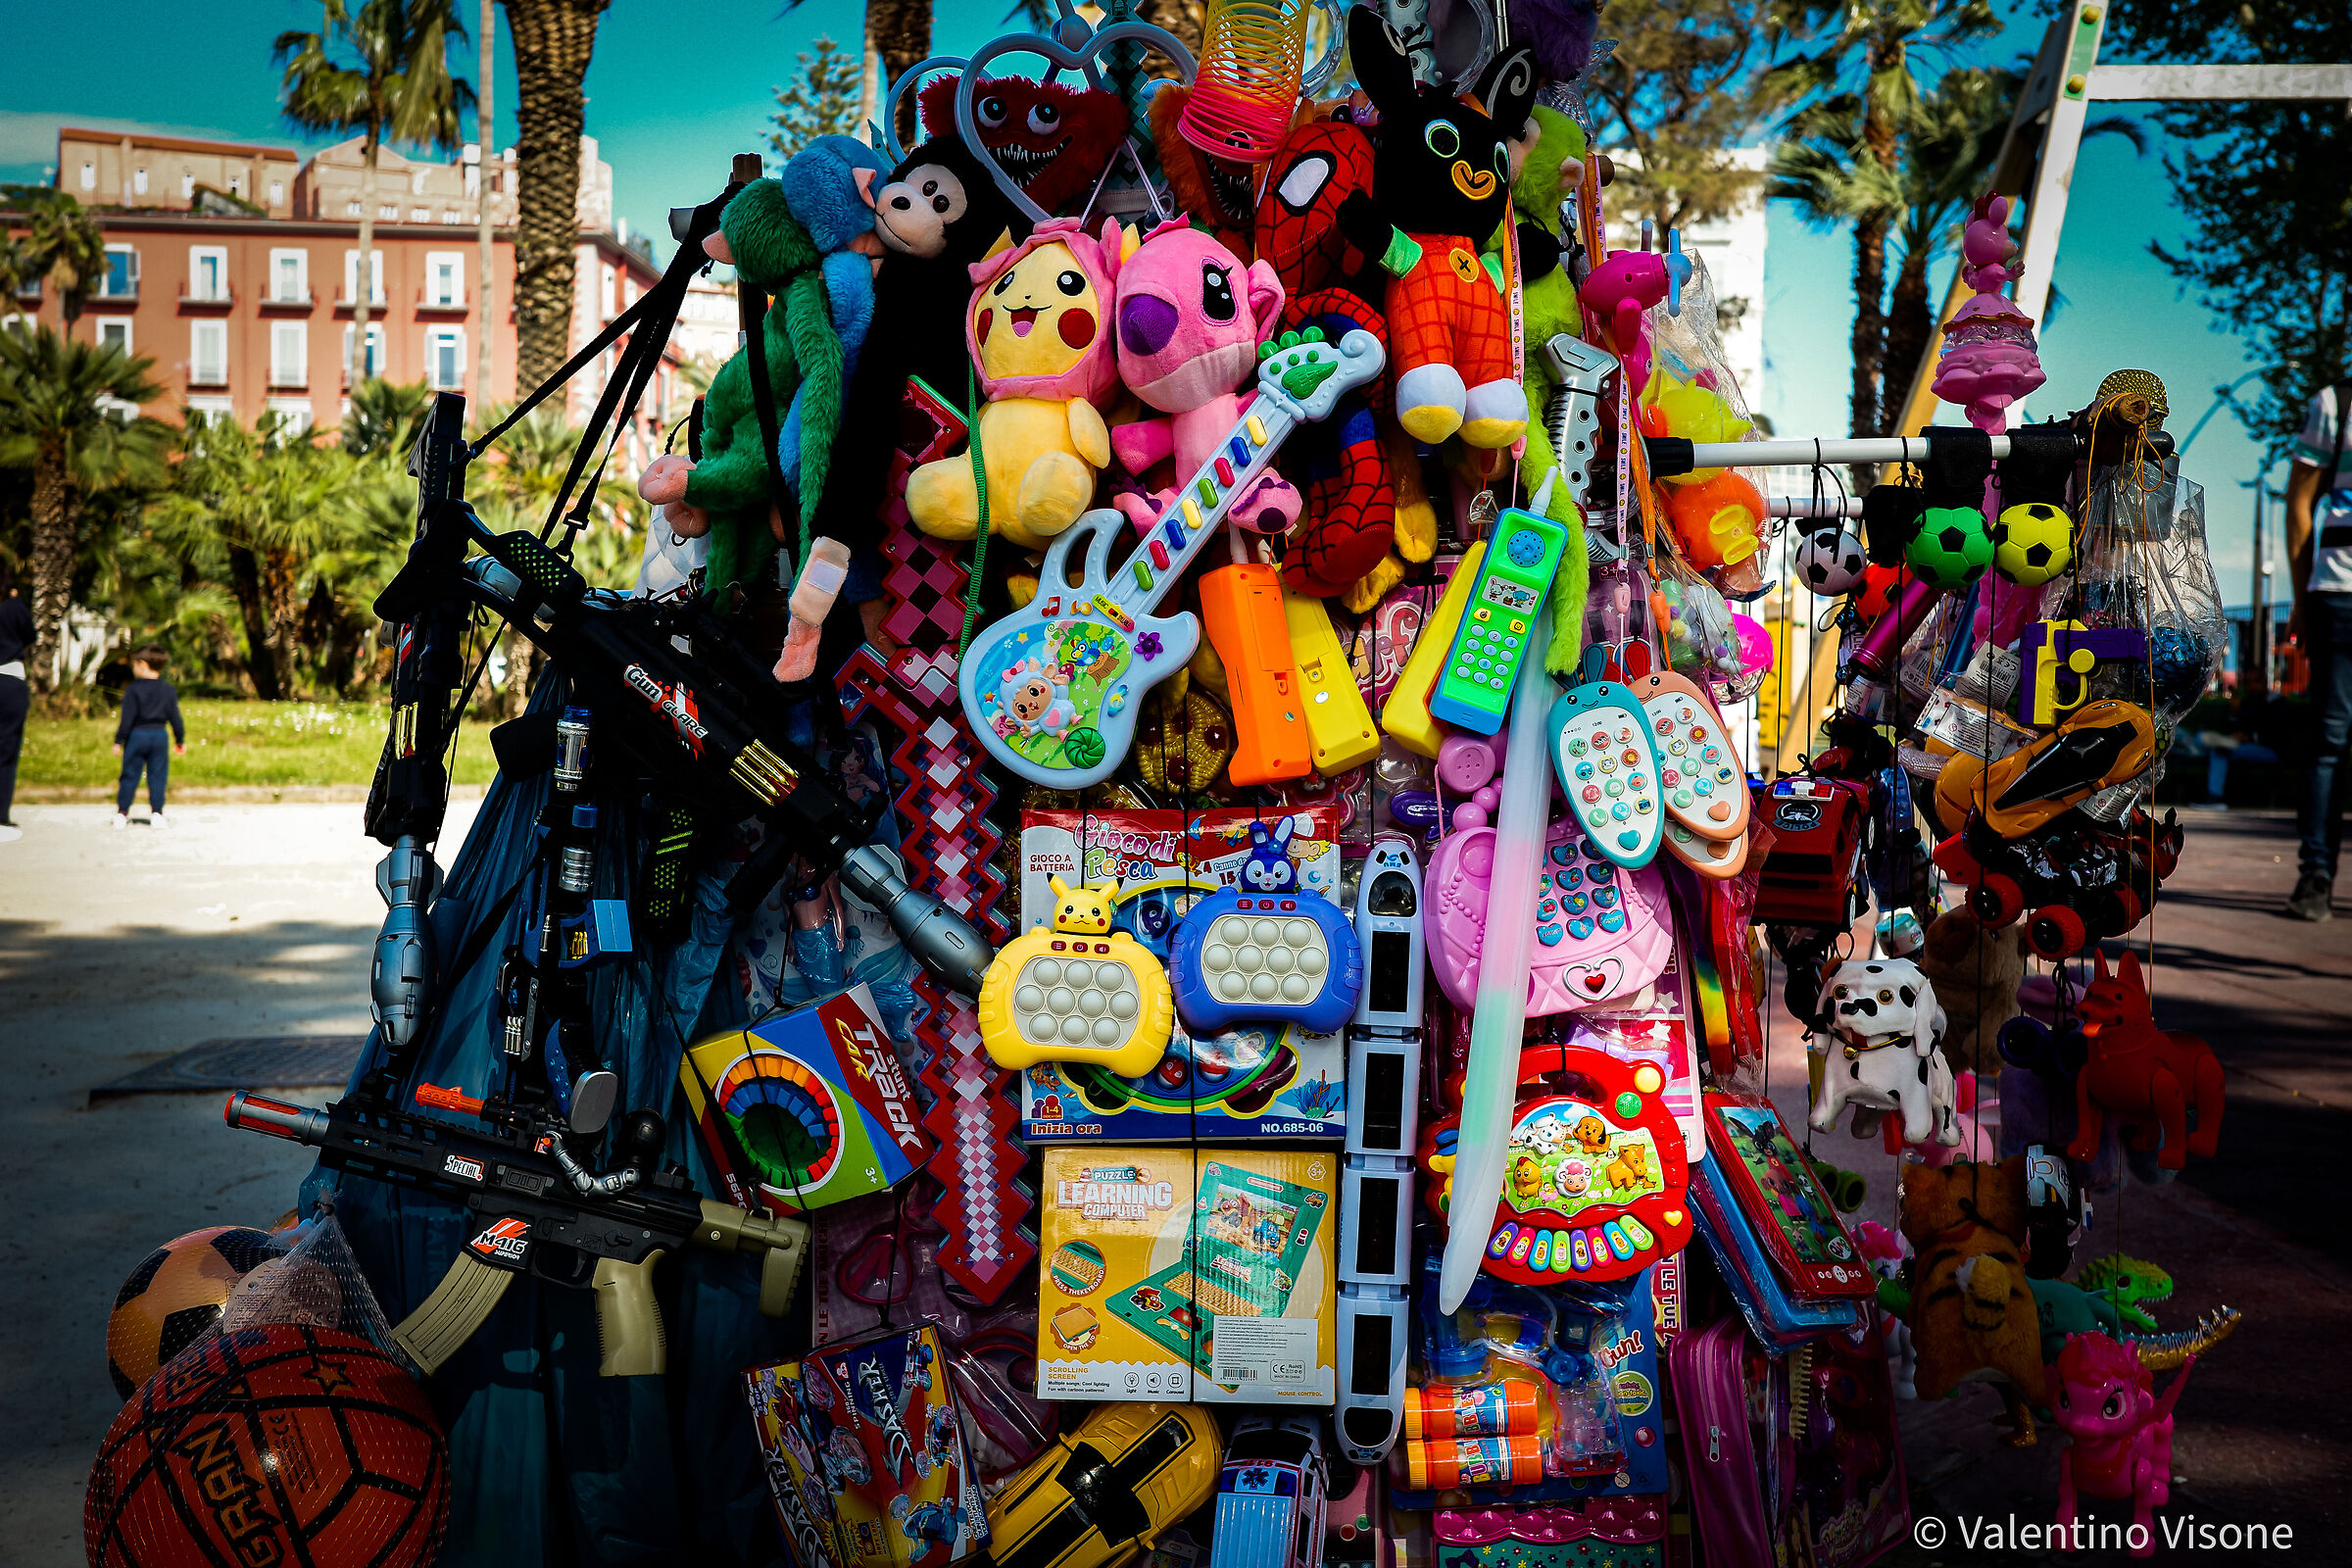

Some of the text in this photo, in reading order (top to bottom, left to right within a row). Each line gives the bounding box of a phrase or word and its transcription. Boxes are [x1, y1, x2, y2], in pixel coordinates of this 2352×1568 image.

[1095, 596, 1108, 609] MUSIC
[624, 665, 708, 738] Gun GLARE
[1775, 819, 1818, 830] POLICE
[1074, 814, 1175, 861] Gioco di
[1030, 863, 1074, 872] BATTERIA
[1086, 849, 1157, 880] Pesca
[1203, 861, 1211, 873] 4
[1213, 859, 1238, 871] Canne
[1219, 871, 1236, 885] 15
[836, 1018, 870, 1082] CAR
[886, 1054, 910, 1101] stunt
[1032, 1123, 1102, 1135] Inizia ora
[1261, 1123, 1323, 1133] NO.685-06
[864, 1167, 877, 1184] 3+
[1095, 1171, 1135, 1180] PUZZLE
[1058, 1181, 1173, 1206] LEARNING
[1083, 1204, 1146, 1217] COMPUTER
[1054, 1275, 1067, 1292] PRESS
[1661, 1269, 1676, 1291] LE
[1662, 1295, 1677, 1329] TUE
[1273, 1364, 1285, 1373] CE
[844, 1381, 860, 1429] SPINNING
[857, 1349, 917, 1490] DASHER
[176, 1419, 280, 1568] GRAN
